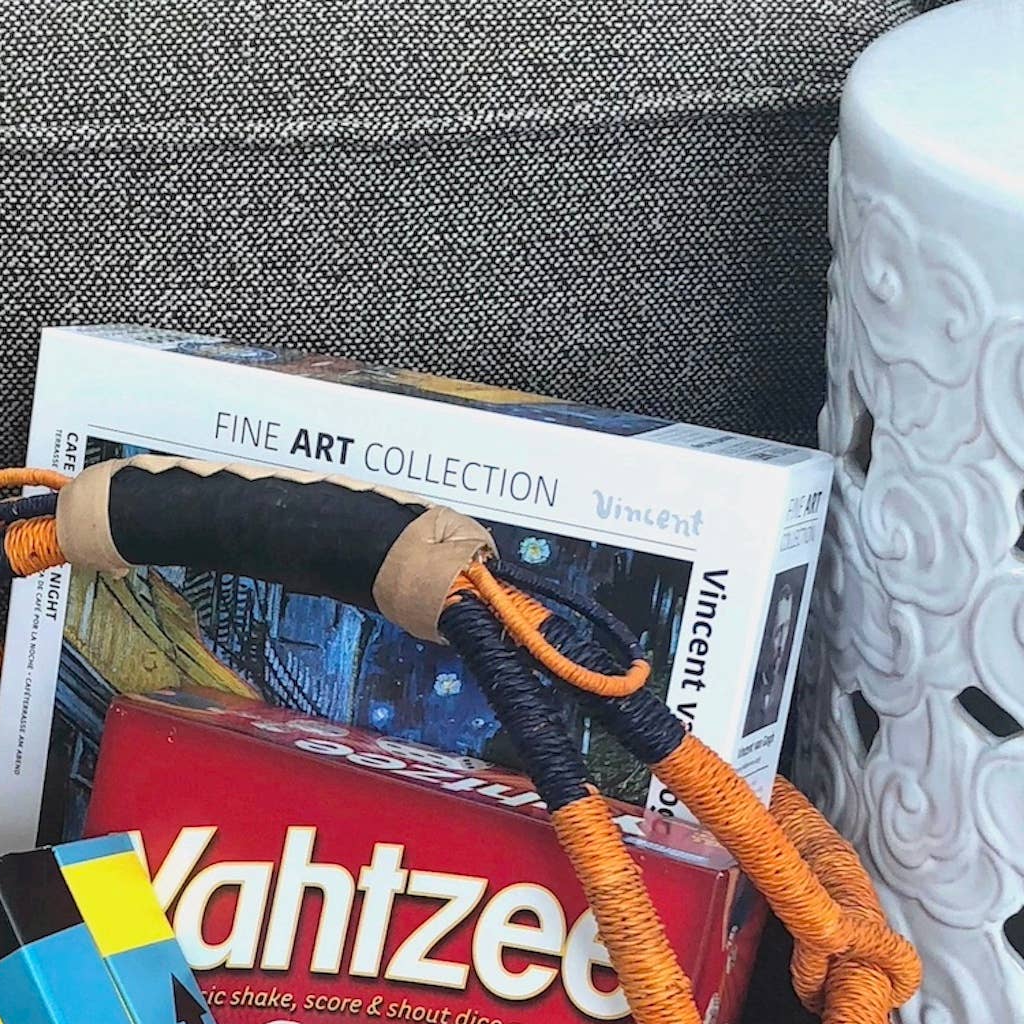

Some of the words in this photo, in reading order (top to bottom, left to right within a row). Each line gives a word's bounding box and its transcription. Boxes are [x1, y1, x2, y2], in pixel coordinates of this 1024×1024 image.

[63, 432, 78, 472] CAFE
[215, 411, 281, 451] FINE
[290, 428, 355, 465] ART
[364, 442, 559, 507] COLLECTION
[592, 489, 704, 537] Vincent
[45, 572, 62, 620] NIGHT
[681, 569, 729, 692] Vincent
[229, 985, 297, 1012] shake,
[304, 993, 362, 1016] score
[366, 997, 382, 1017] &
